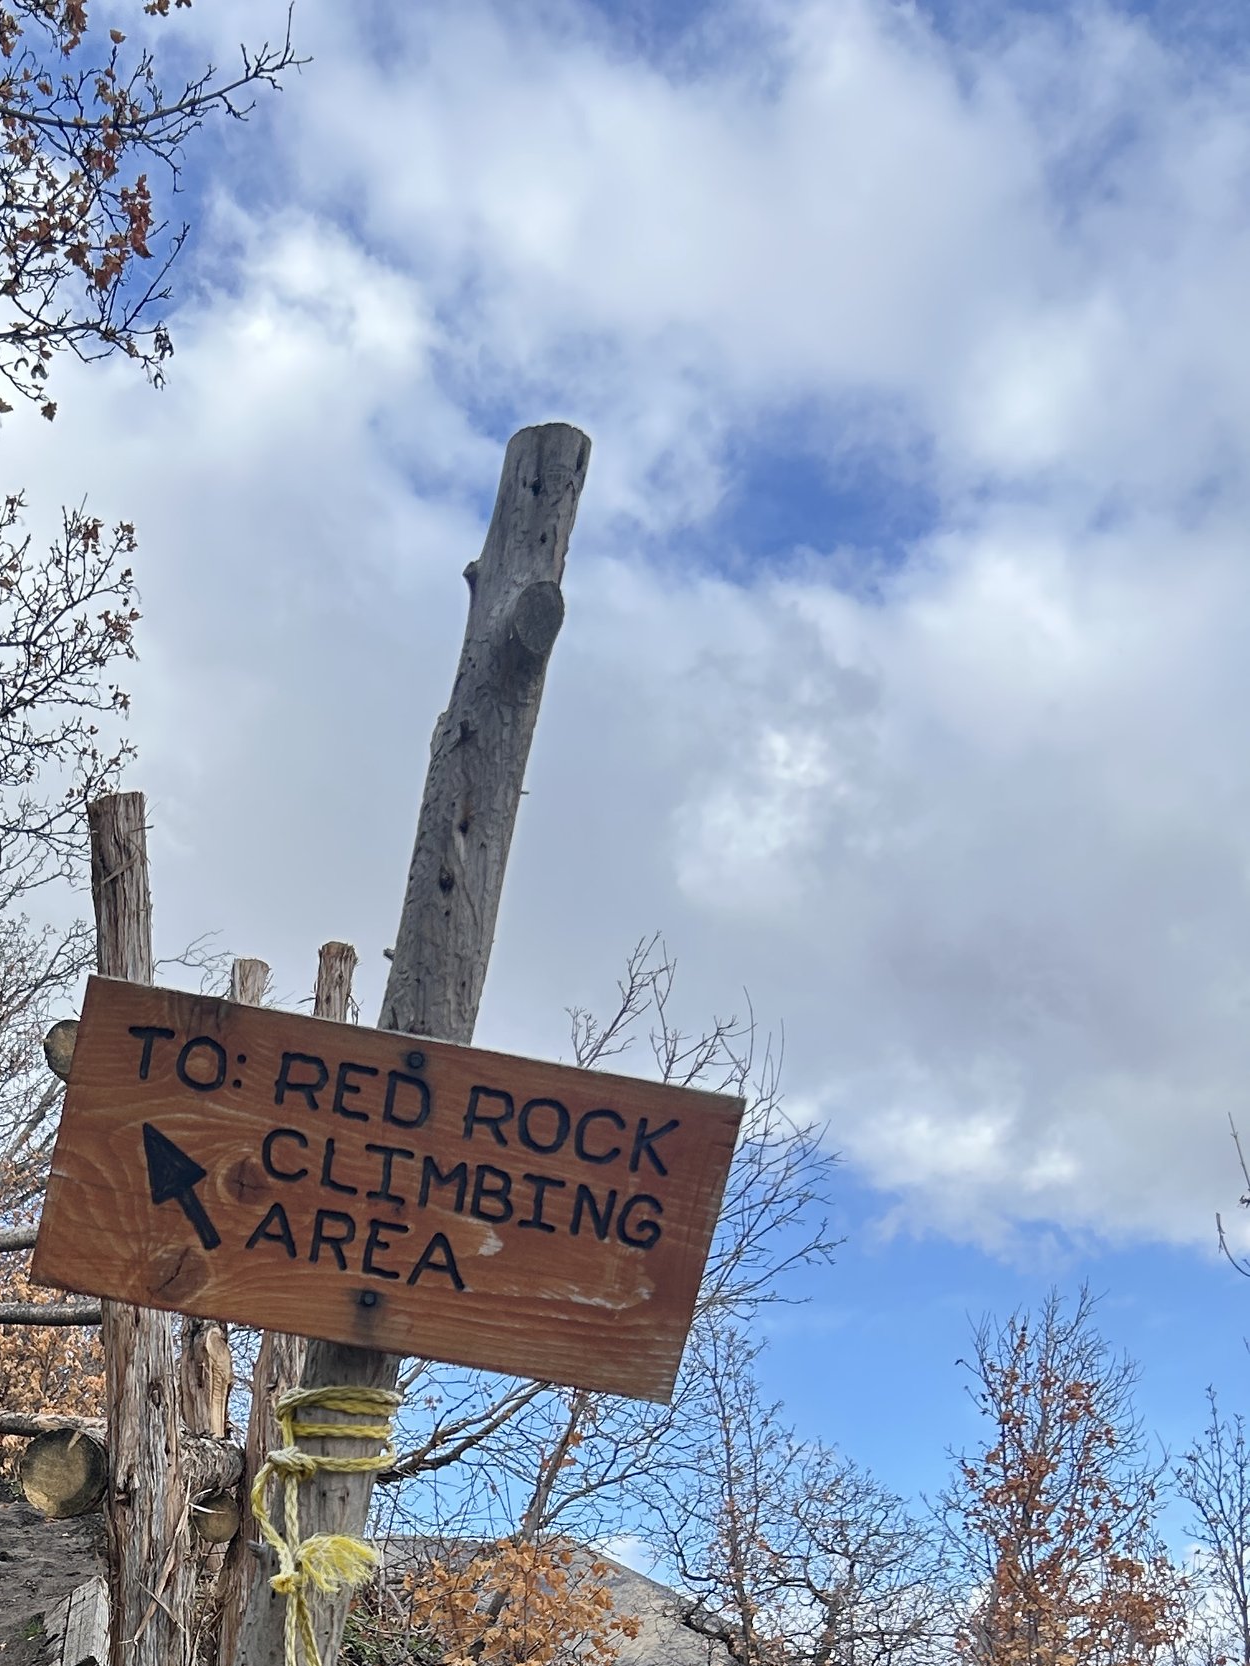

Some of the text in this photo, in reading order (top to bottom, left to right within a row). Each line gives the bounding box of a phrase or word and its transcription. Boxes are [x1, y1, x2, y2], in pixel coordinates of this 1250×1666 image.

[128, 1025, 680, 1177] TO: RED ROCK
[245, 1203, 466, 1292] AREA
[262, 1129, 664, 1250] CLIMBING
